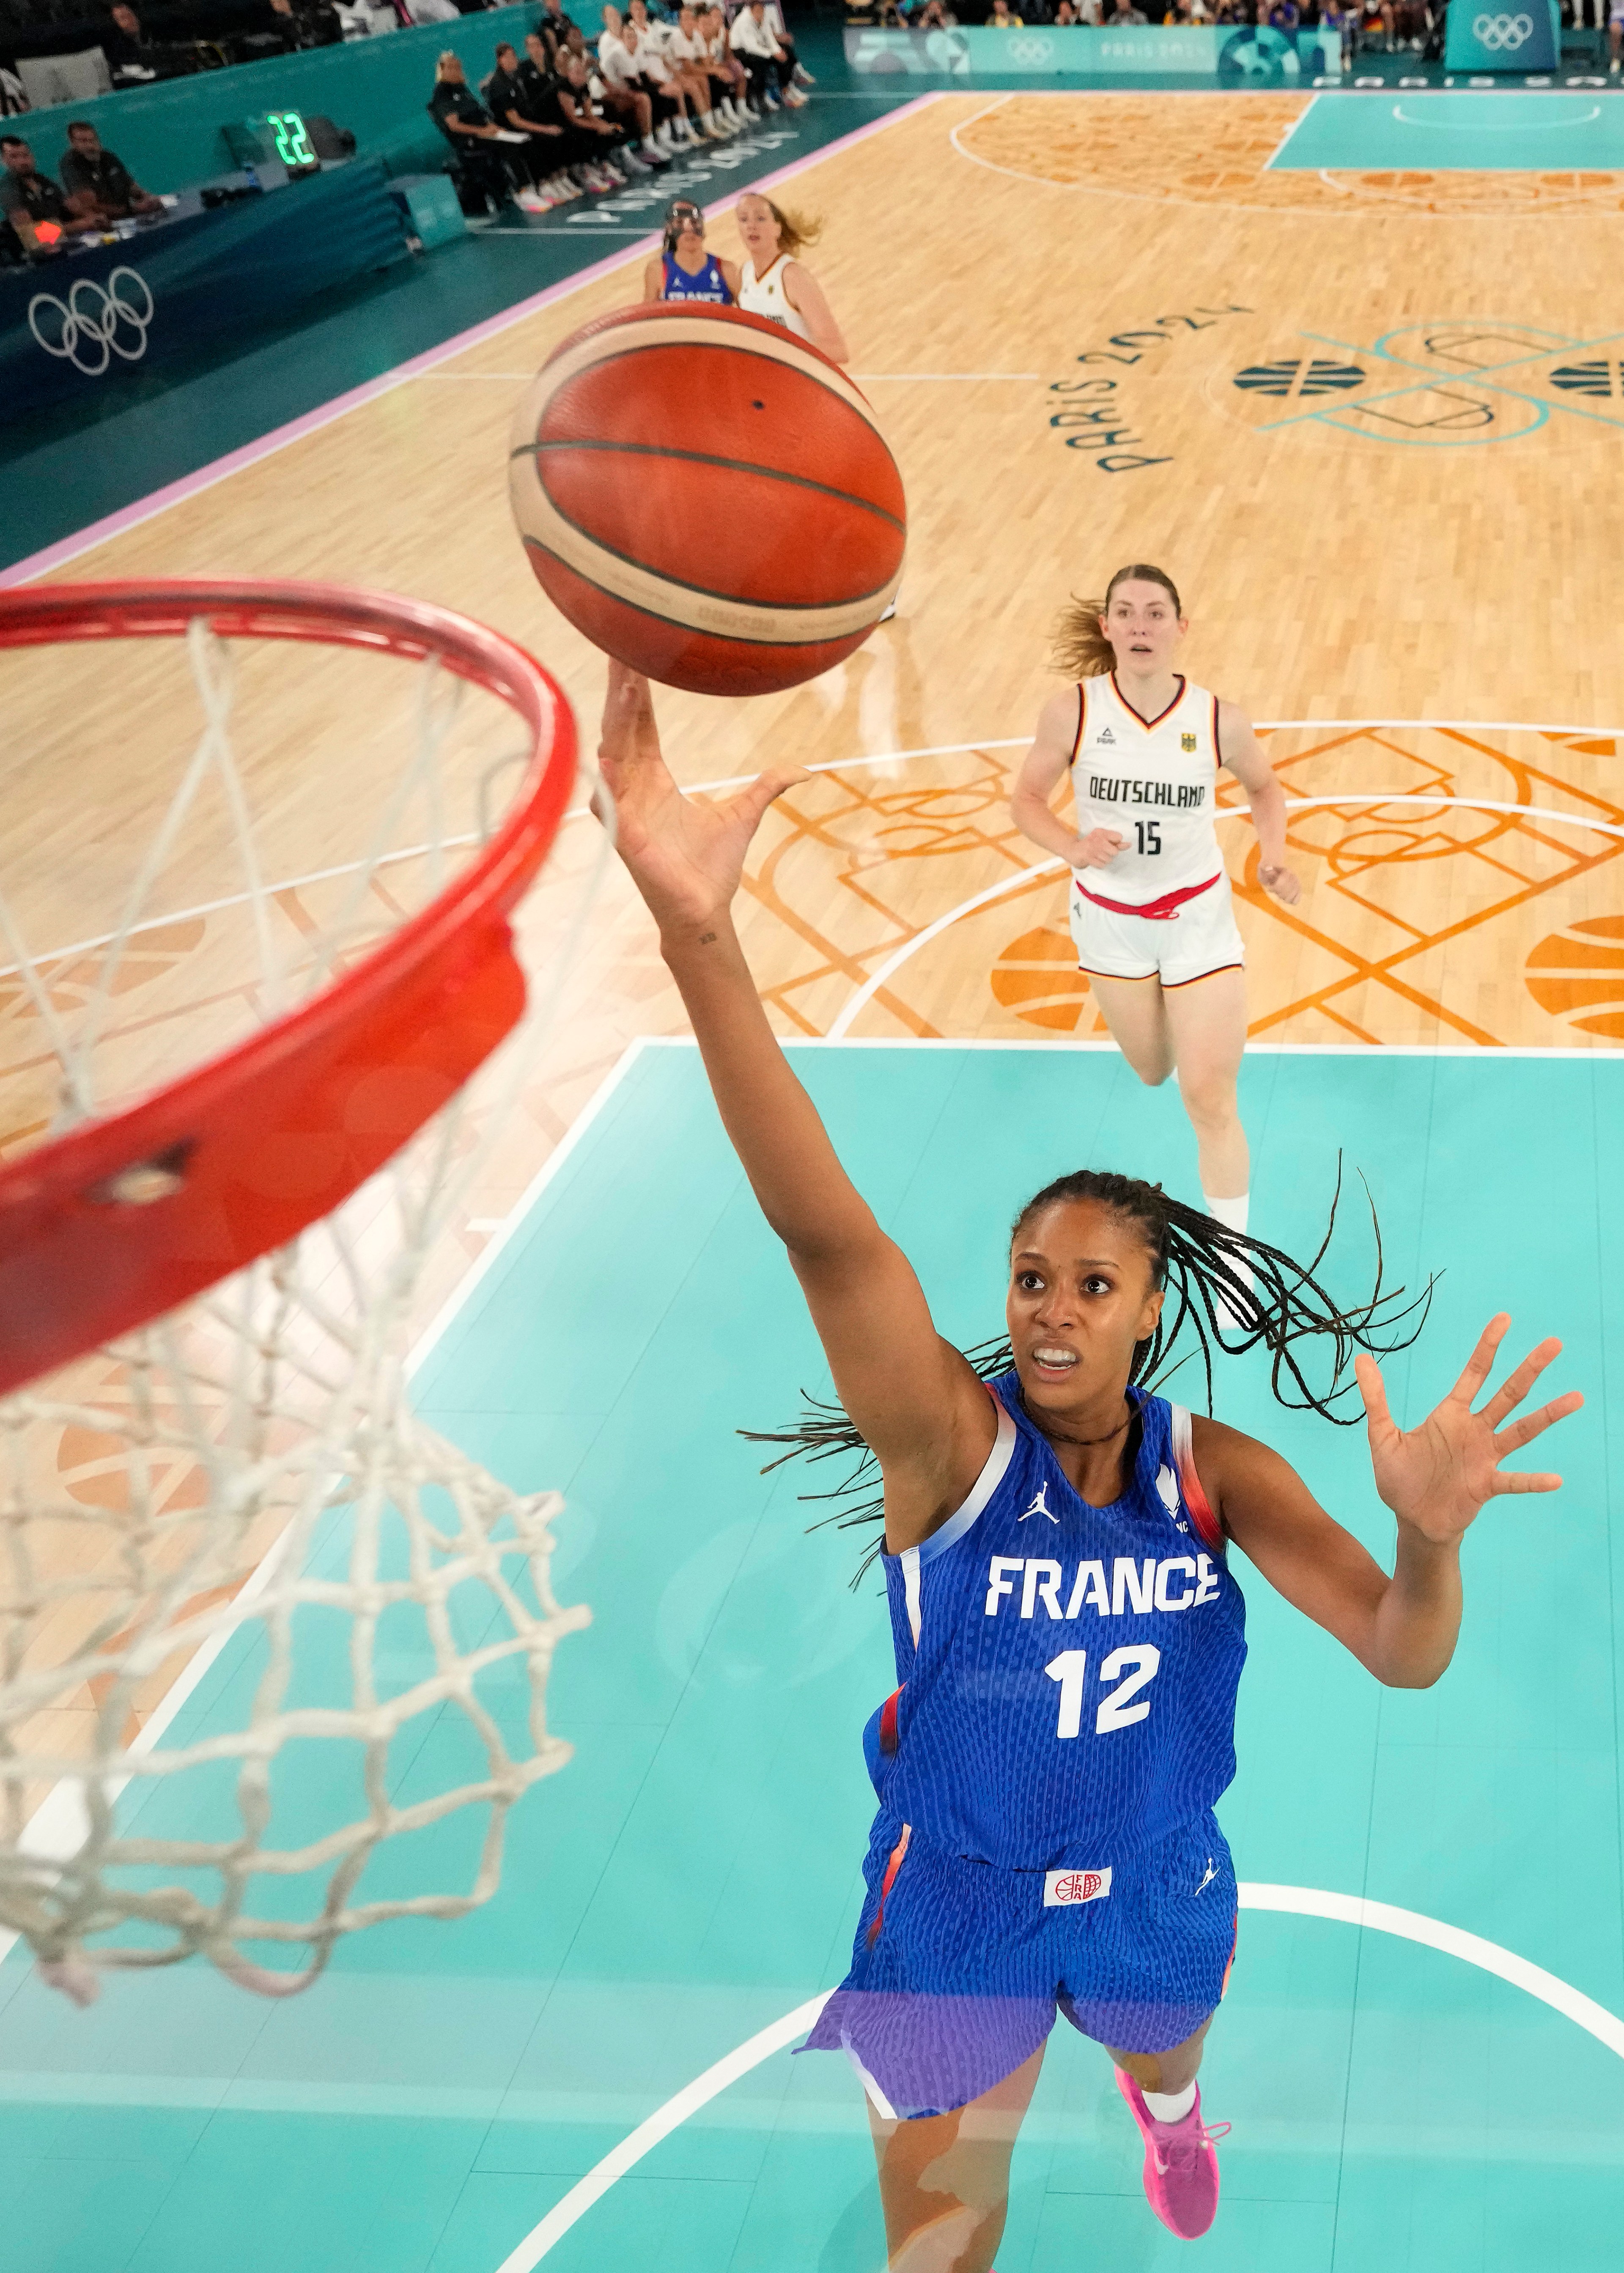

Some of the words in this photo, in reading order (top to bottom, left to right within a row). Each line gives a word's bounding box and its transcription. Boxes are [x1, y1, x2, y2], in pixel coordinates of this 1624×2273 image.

[267, 113, 314, 165] 22
[1090, 776, 1205, 808] DEUTSCHLAND
[1135, 821, 1161, 855] 15
[985, 1553, 1221, 1620] FRANCE
[1045, 1643, 1160, 1739] 12
